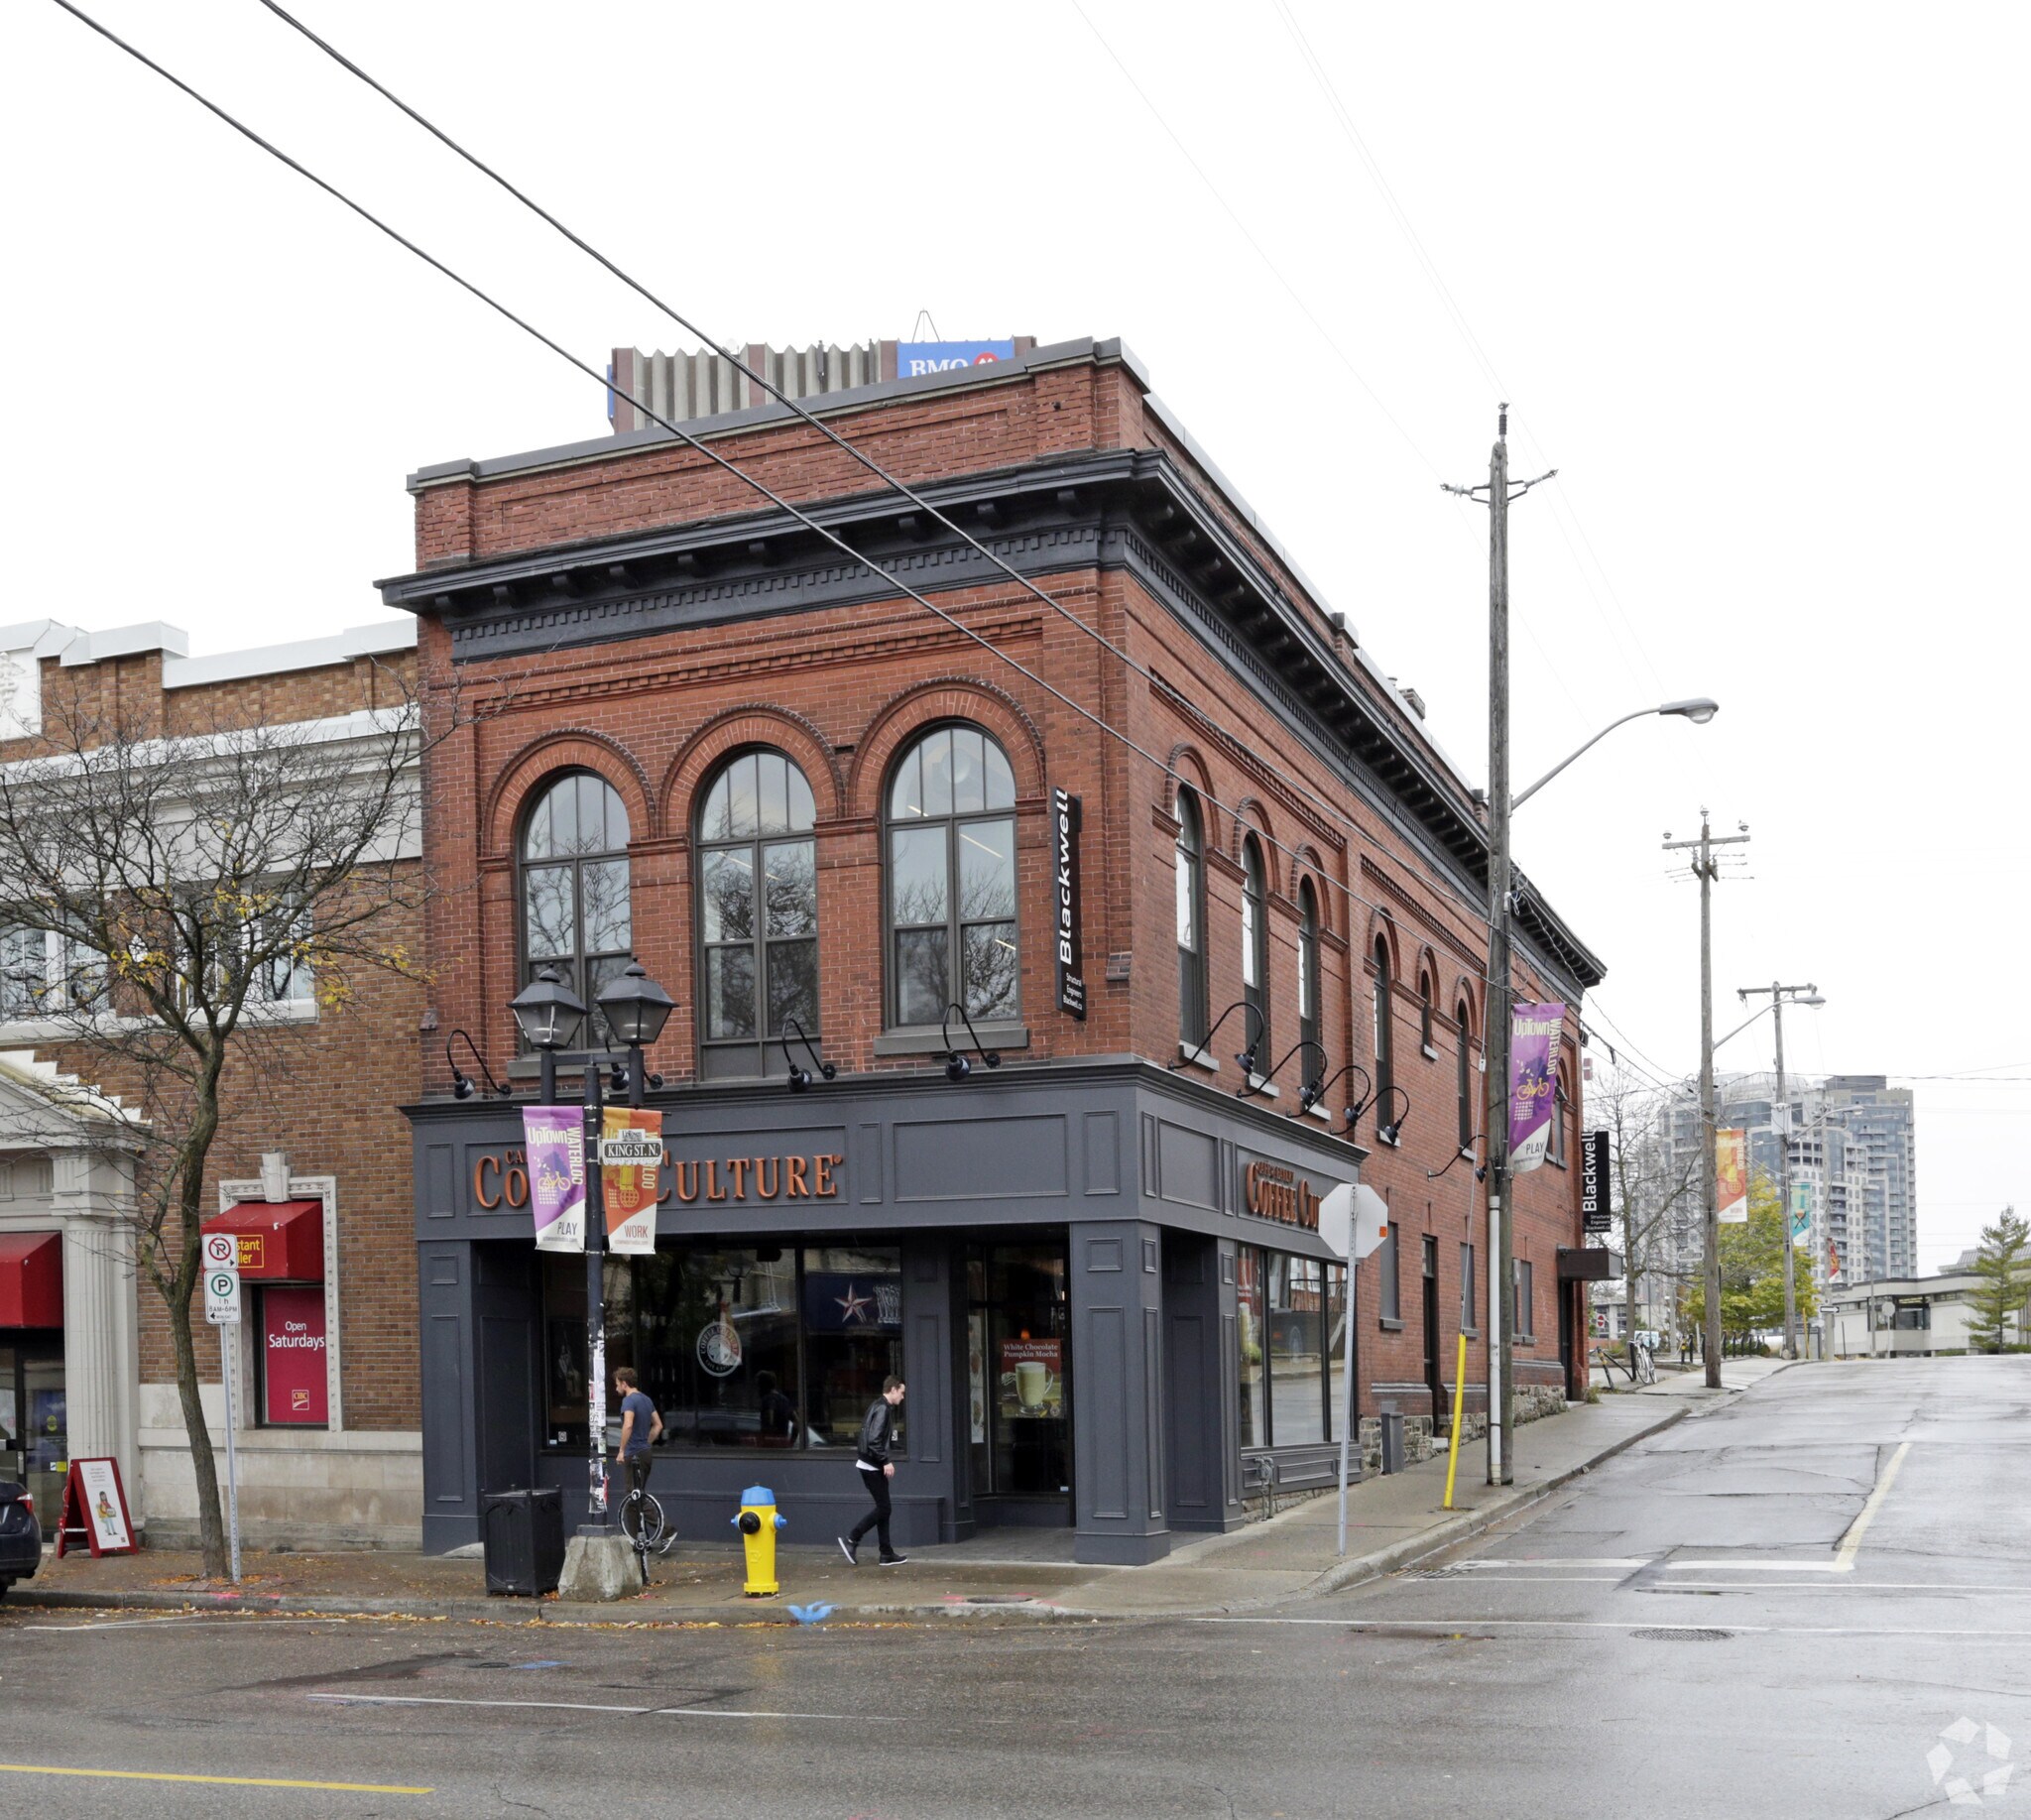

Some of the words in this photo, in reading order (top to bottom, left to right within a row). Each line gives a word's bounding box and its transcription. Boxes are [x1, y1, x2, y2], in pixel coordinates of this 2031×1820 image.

[1056, 789, 1072, 965] Blackwell
[1546, 1018, 1563, 1075] WATERLOO
[566, 1127, 584, 1185] WATERLOO
[607, 1144, 633, 1156] KING
[634, 1144, 647, 1156] ST.
[648, 1144, 658, 1156] N.
[1525, 1142, 1544, 1155] PLAY
[1582, 1131, 1598, 1212] Blackwell
[556, 1221, 578, 1236] PLAY
[624, 1224, 649, 1239] WORK
[236, 1240, 261, 1252] stant
[285, 1321, 306, 1333] Open
[269, 1333, 325, 1351] Saturdays
[1004, 1350, 1034, 1359] Pumpkin
